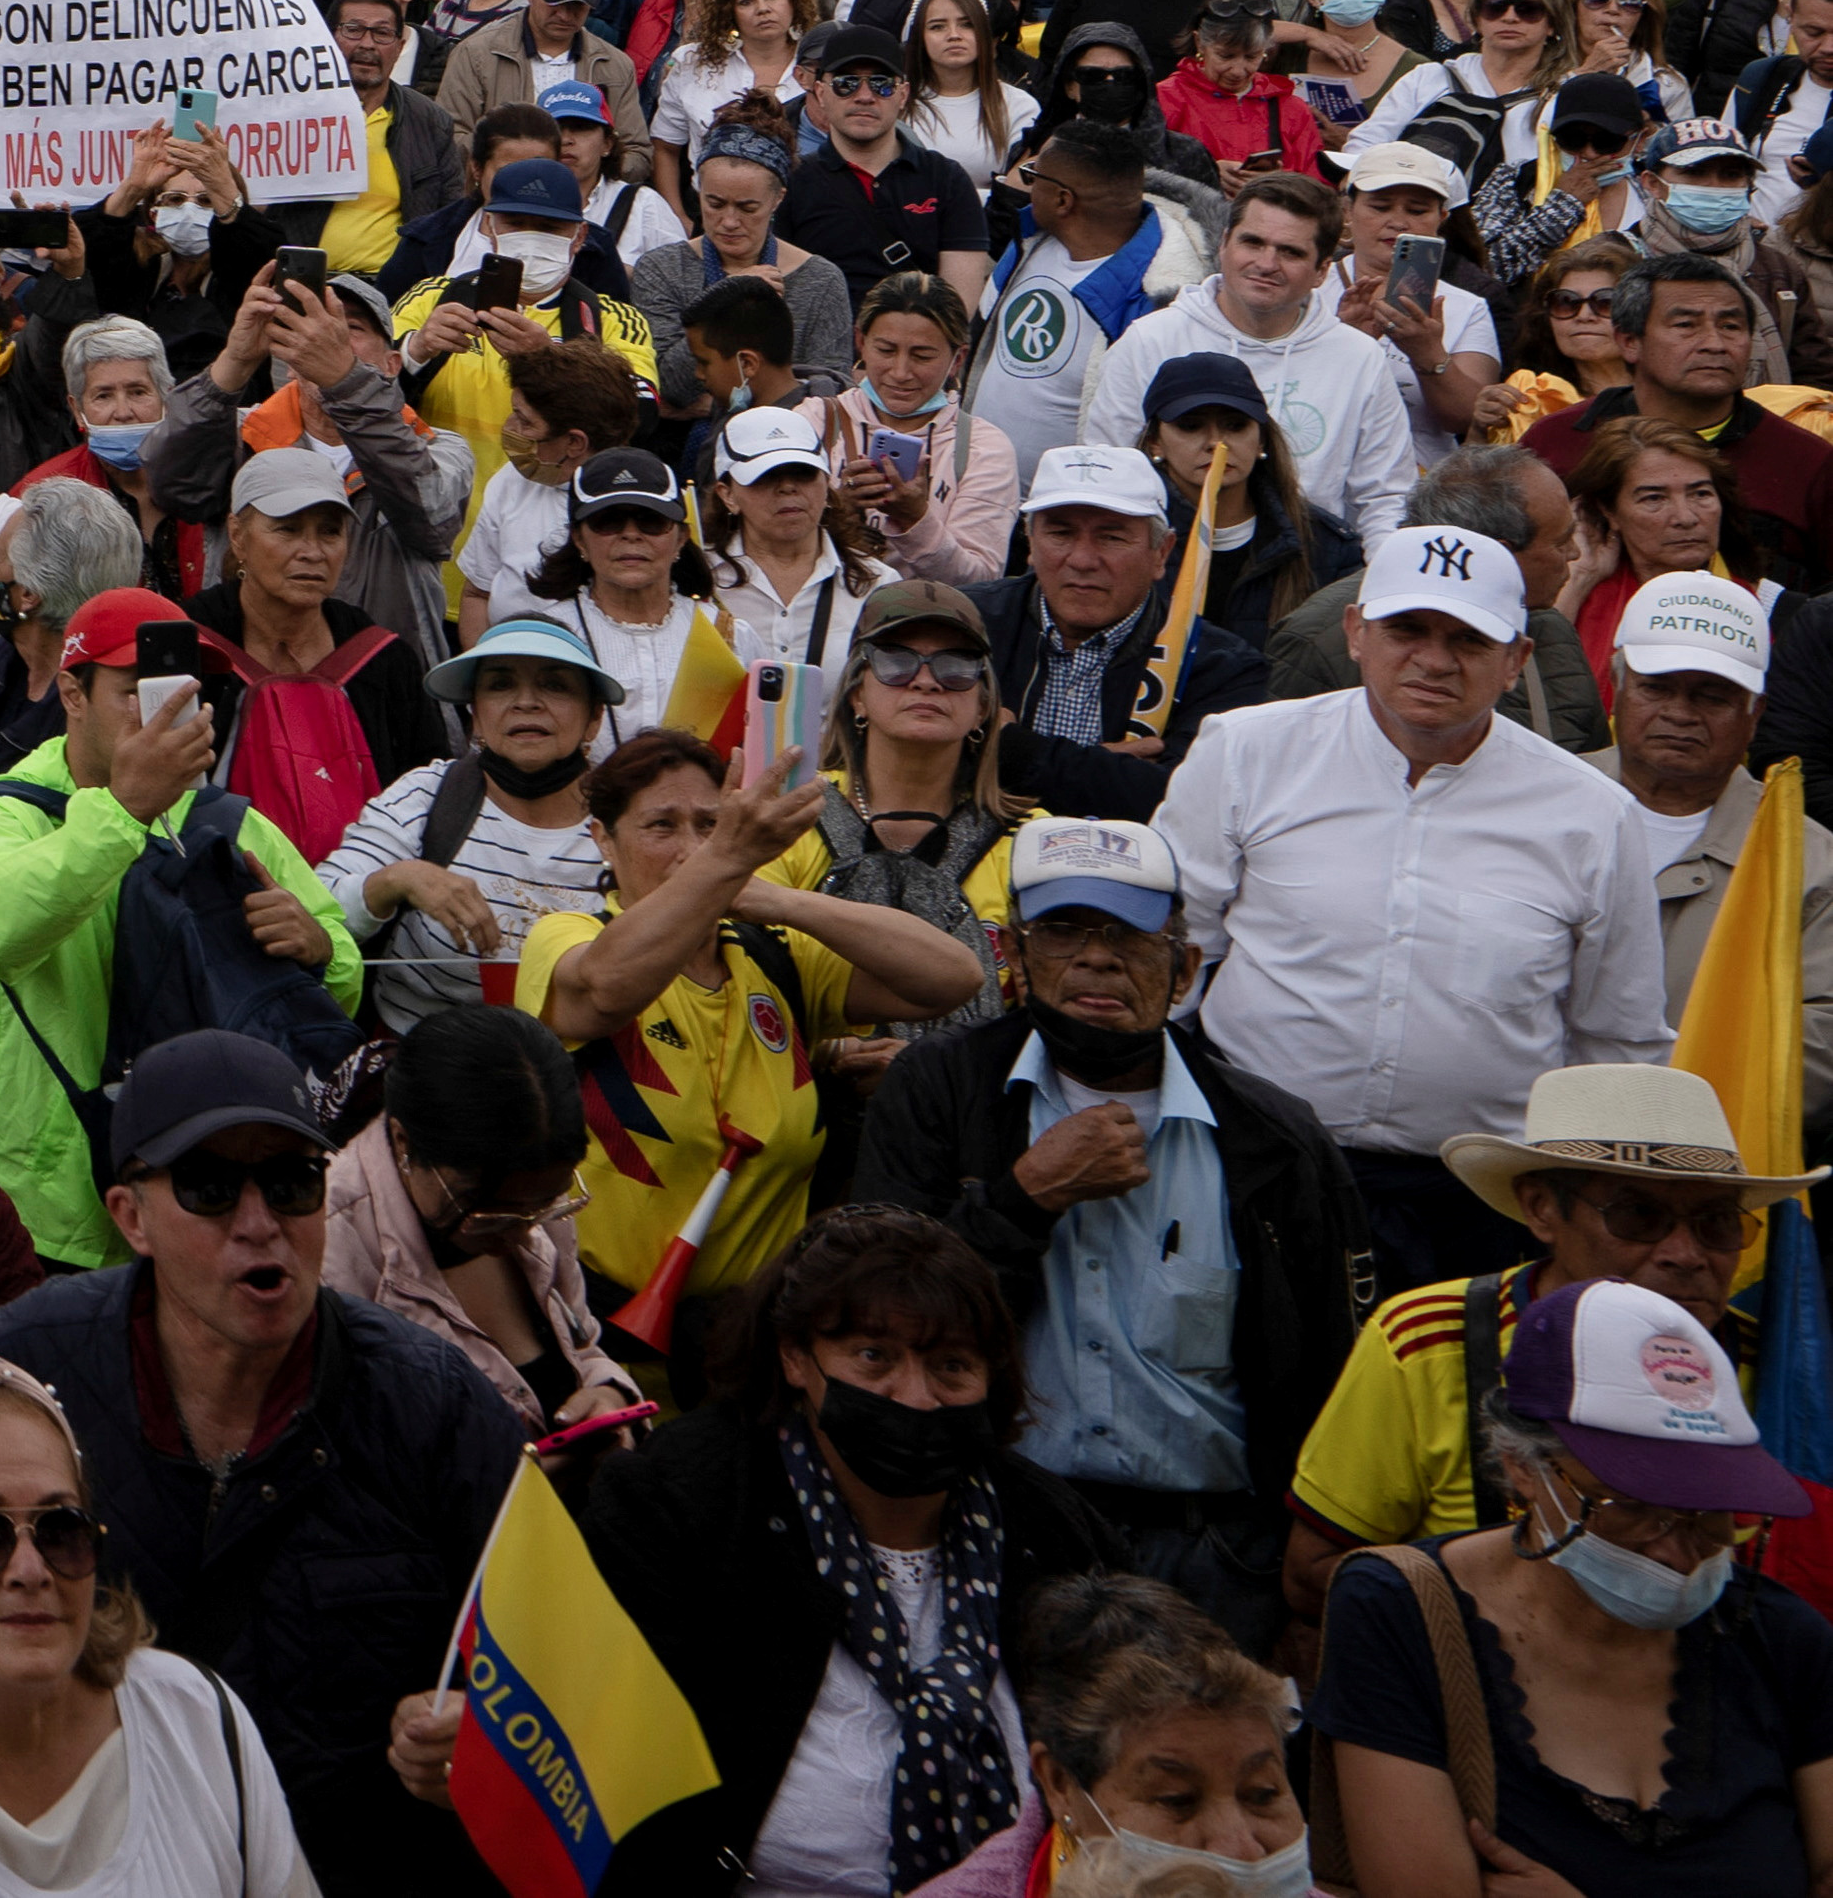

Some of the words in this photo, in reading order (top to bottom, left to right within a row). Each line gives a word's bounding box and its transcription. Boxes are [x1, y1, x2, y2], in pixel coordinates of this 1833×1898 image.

[85, 56, 205, 105] PAGAR
[216, 44, 351, 100] CARCEL
[543, 90, 592, 109] Colombia
[5, 116, 64, 189] MÁS
[72, 128, 145, 186] JUNT
[227, 115, 356, 179] ORRUPTA
[1418, 535, 1475, 581] NY
[1657, 594, 1754, 628] CIUDADANO
[1649, 616, 1758, 653] PATRIOTA
[1097, 829, 1130, 853] 17
[469, 1624, 588, 1843] OLOMBIA
